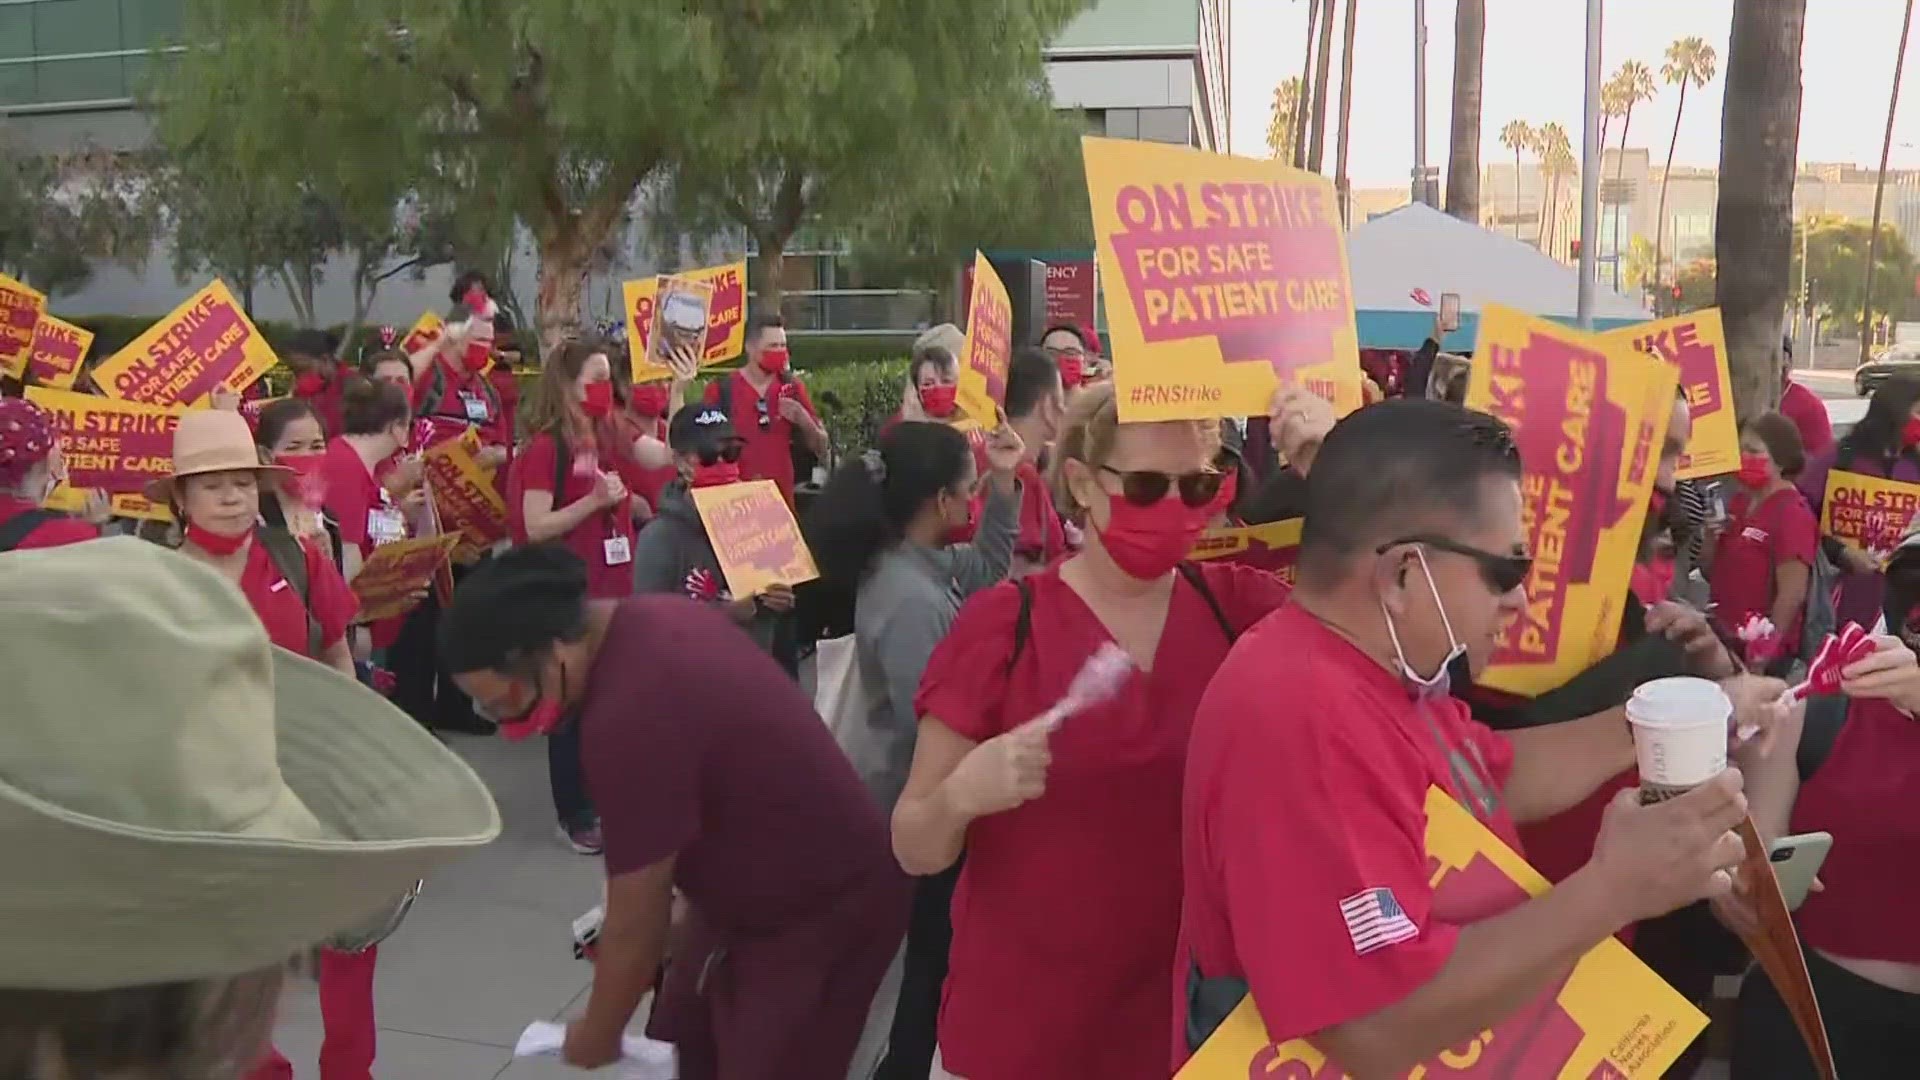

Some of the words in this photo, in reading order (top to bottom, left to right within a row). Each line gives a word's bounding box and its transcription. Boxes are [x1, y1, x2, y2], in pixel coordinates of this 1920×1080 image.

[1116, 182, 1193, 232] ON
[1199, 181, 1323, 231] STRIKE
[1136, 246, 1201, 280] FOR
[1207, 241, 1274, 274] SAFE
[709, 306, 739, 328] CARE
[1143, 279, 1280, 326] PATIENT
[1285, 278, 1341, 313] CARE
[114, 358, 147, 394] ON
[148, 293, 216, 365] STRIKE
[152, 356, 205, 407] ATIENT
[204, 321, 245, 361] CARE
[160, 345, 198, 381] SAFE
[1130, 383, 1222, 405] #RNStrike
[85, 410, 180, 434] STRIKE
[77, 436, 121, 452] SAFE
[62, 453, 120, 471] TIENT
[122, 457, 175, 473] CARE
[1519, 479, 1574, 654] PATIENT
[1557, 359, 1597, 474] CARE
[1834, 487, 1866, 503] ON
[1874, 491, 1920, 511] STR
[1834, 506, 1862, 520] FOR
